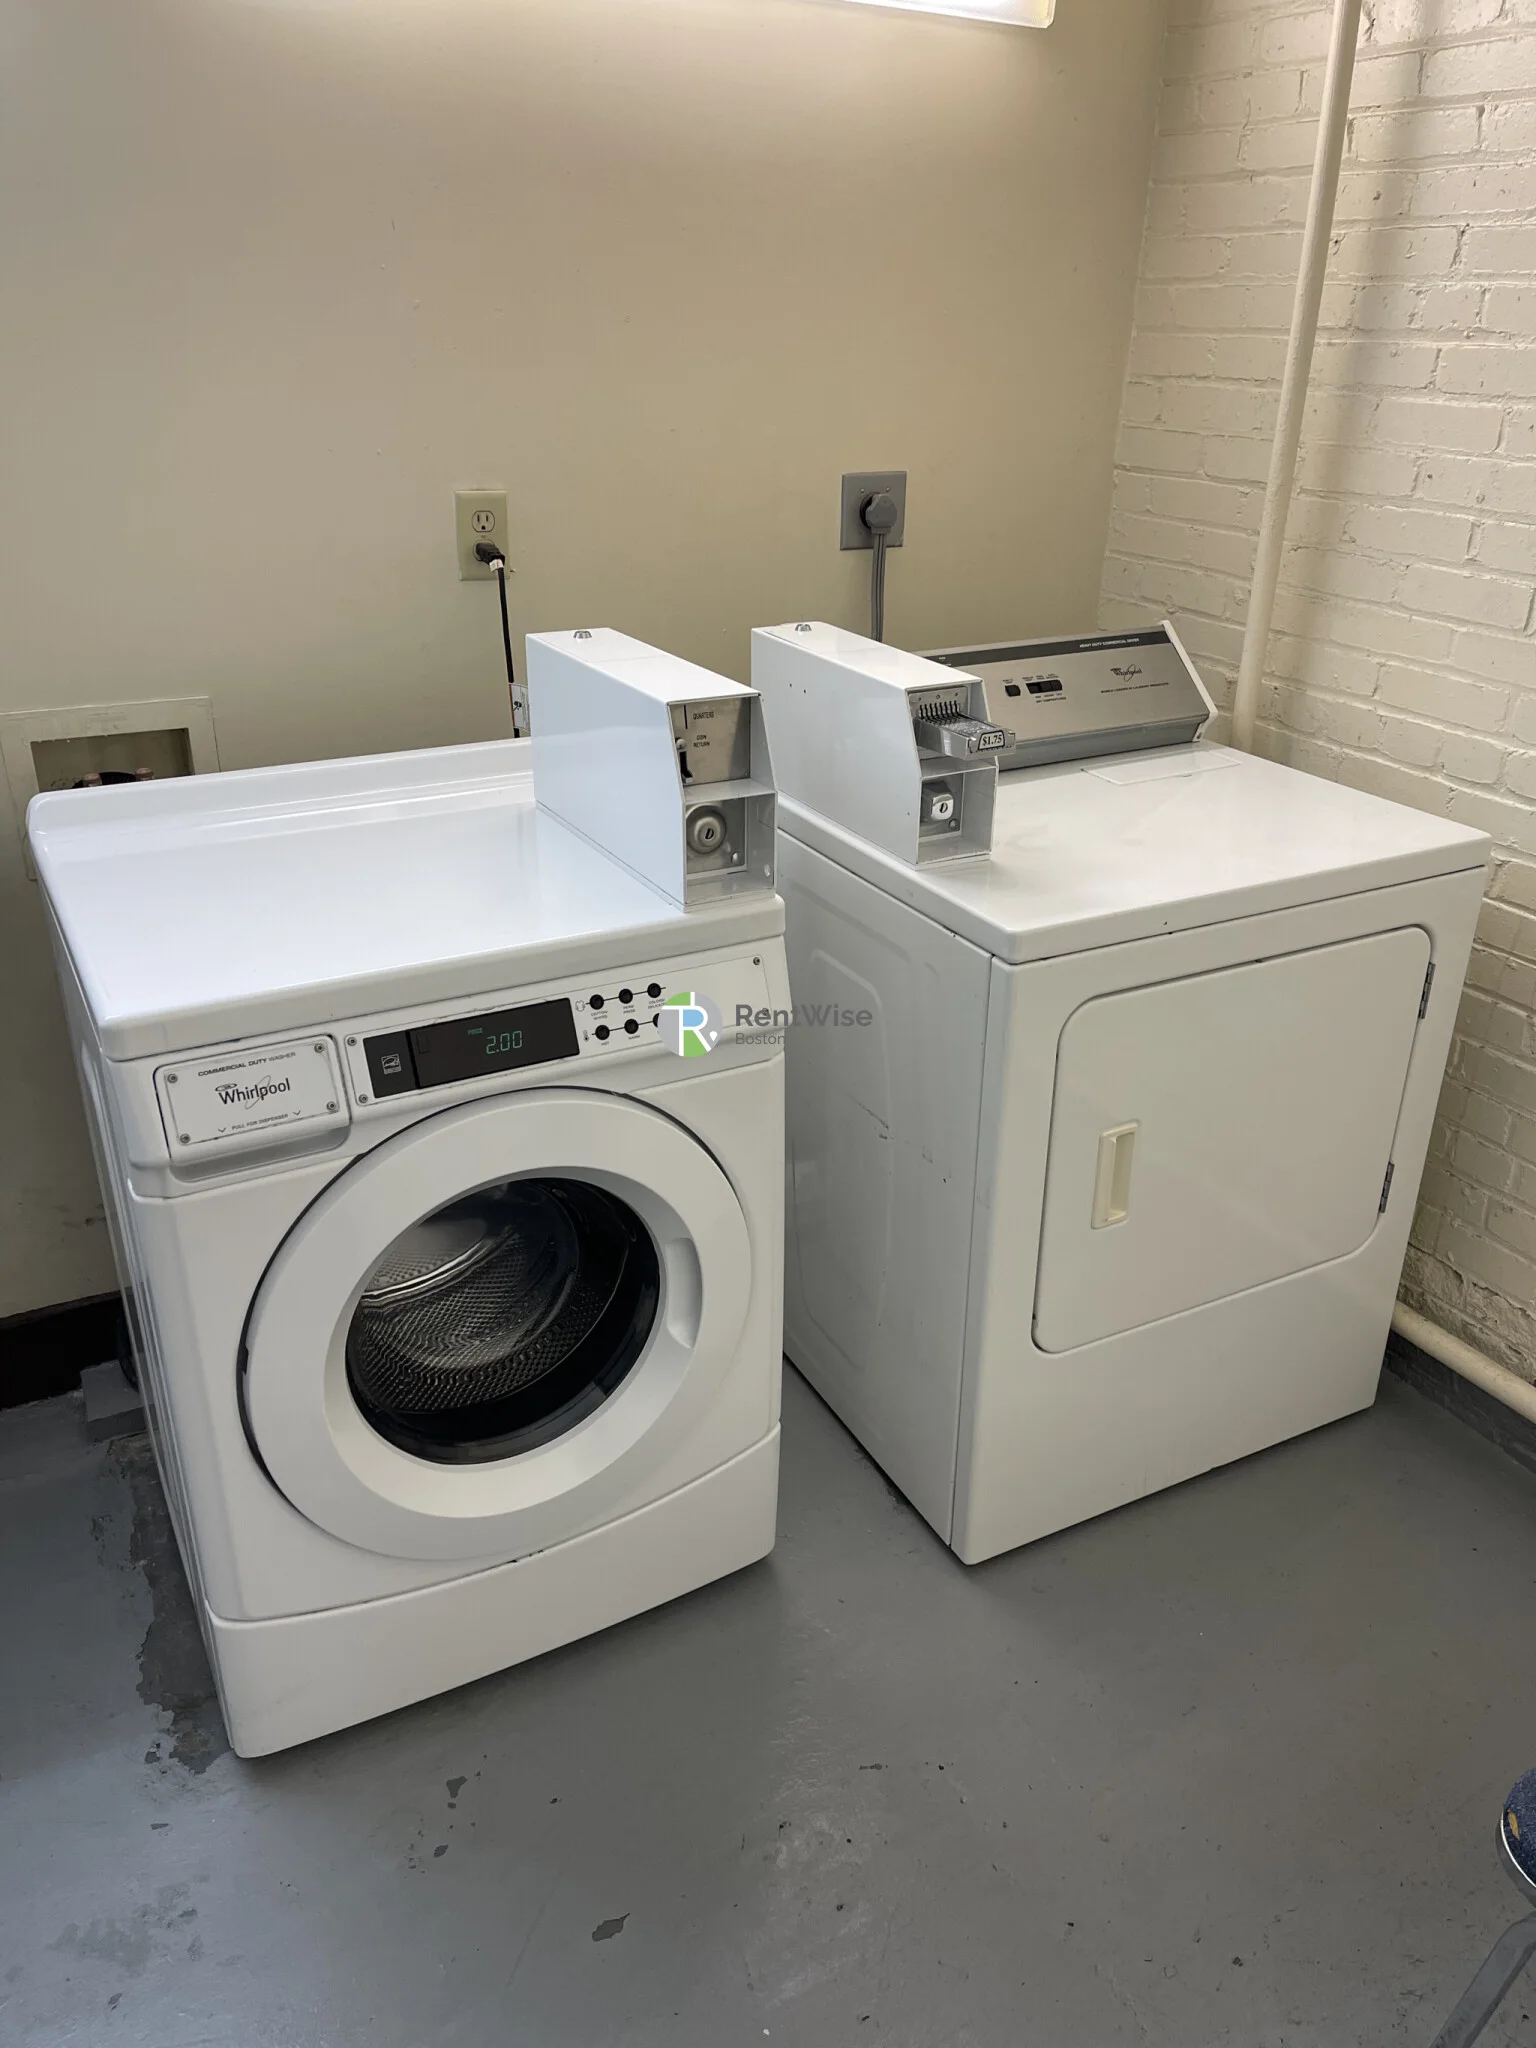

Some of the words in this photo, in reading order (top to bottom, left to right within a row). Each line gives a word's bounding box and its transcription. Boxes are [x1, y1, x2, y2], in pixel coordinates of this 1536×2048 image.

[693, 712, 714, 720] QUARTERS
[982, 734, 1003, 746] $1.75
[468, 1027, 484, 1036] PRICE
[486, 1030, 522, 1054] 2.00
[198, 1062, 246, 1077] COMMERCIAL
[248, 1058, 267, 1066] DUTY
[268, 1052, 296, 1062] WASHER
[218, 1078, 291, 1105] Whirlpool
[258, 1113, 288, 1124] DISPENSER
